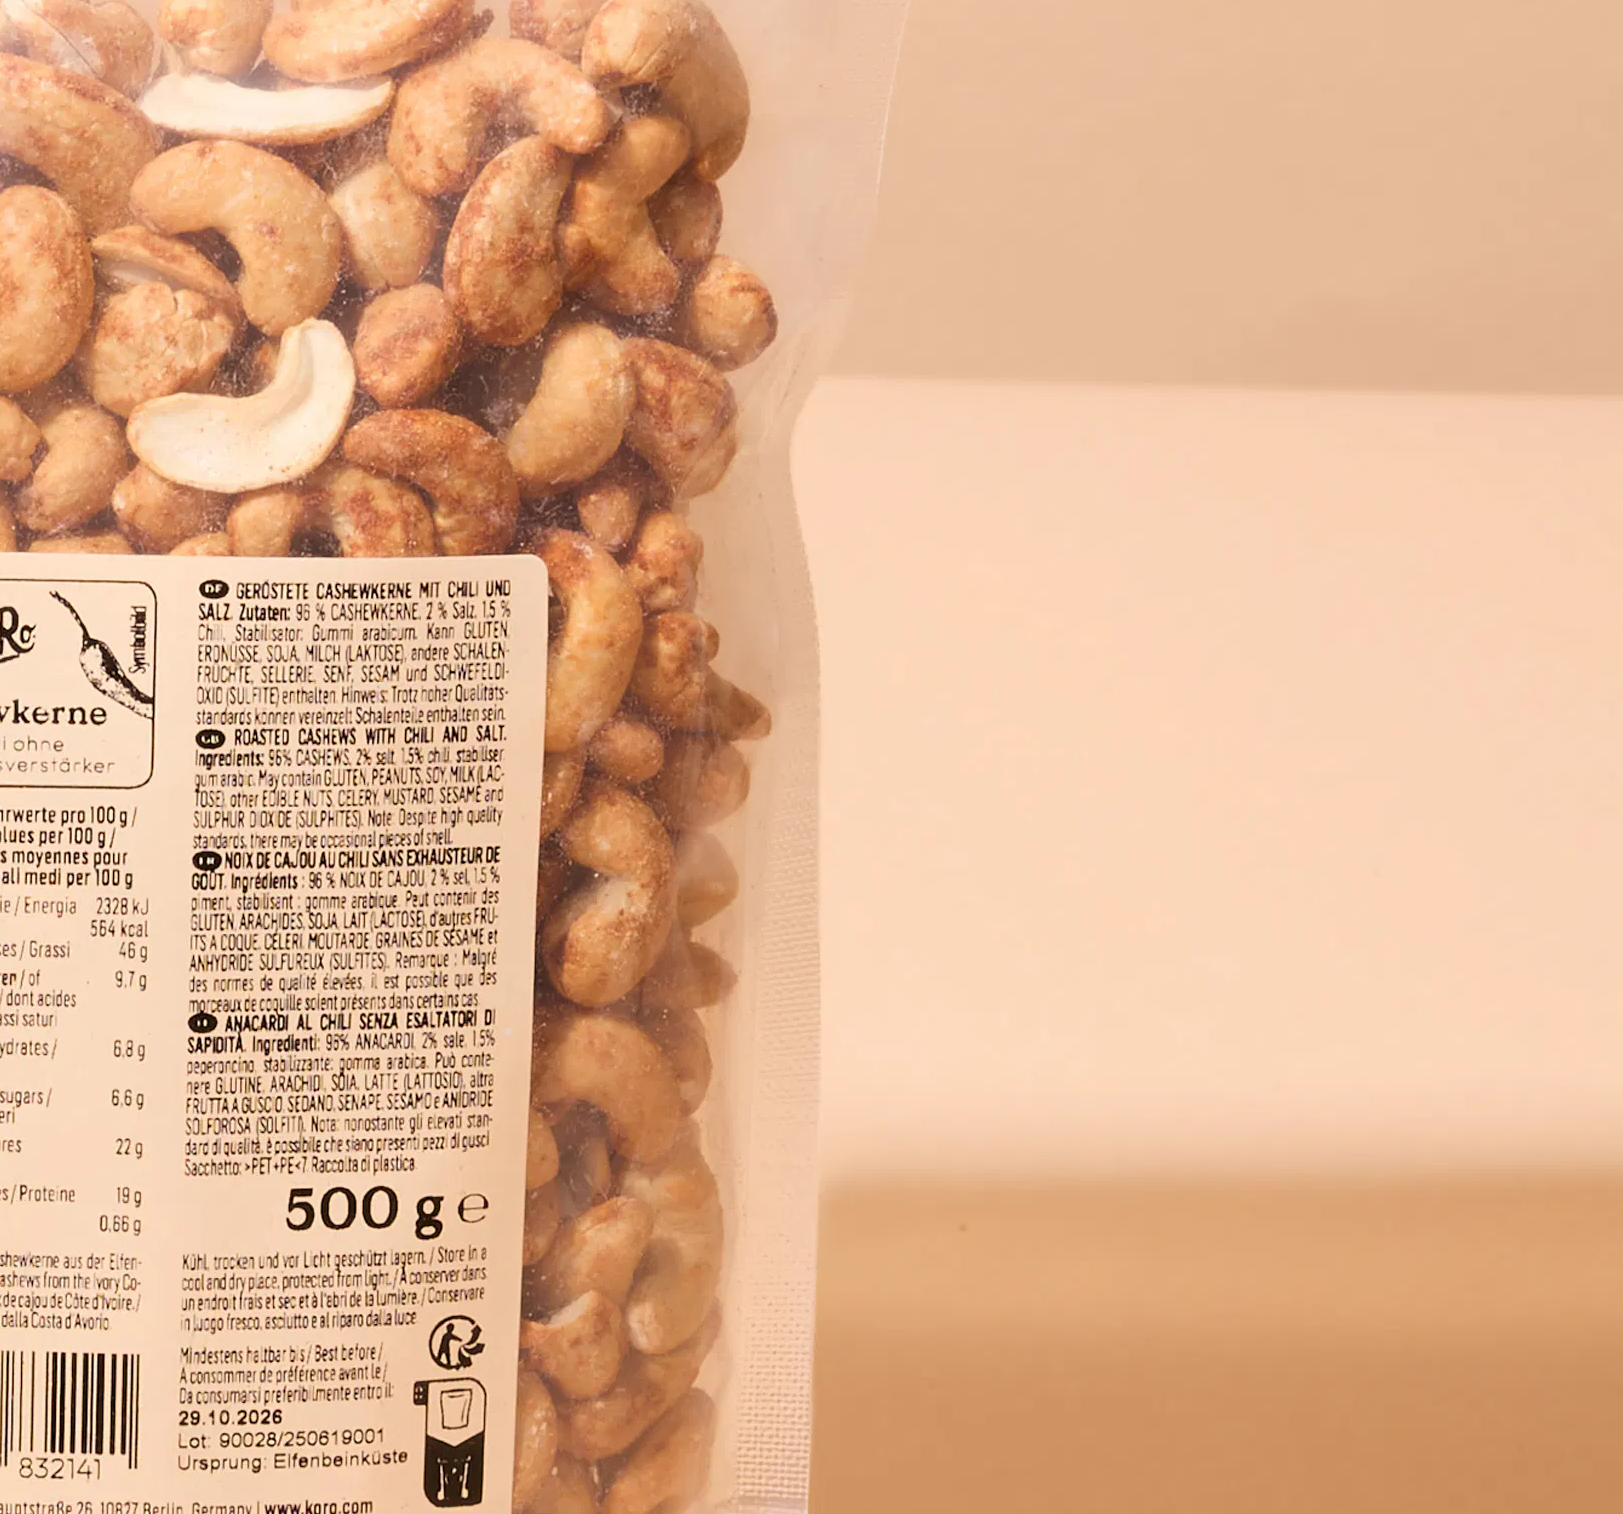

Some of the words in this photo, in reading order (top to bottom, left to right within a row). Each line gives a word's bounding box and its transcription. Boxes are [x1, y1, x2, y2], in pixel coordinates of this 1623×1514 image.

[317, 582, 412, 600] CASHEWKERNE
[419, 582, 440, 598] MIT
[486, 580, 510, 597] UND
[239, 603, 290, 621] Zutaten:
[13, 737, 64, 752] ohne
[235, 728, 289, 746] ROASTED
[298, 727, 356, 745] CASHEWS
[366, 728, 396, 745] WITH
[404, 727, 434, 744] CHILI
[442, 726, 467, 742] AND
[61, 810, 85, 826] pro
[91, 806, 115, 824] 100
[39, 831, 63, 847] per
[68, 827, 93, 844] 100
[11, 851, 88, 869] moyennes
[94, 852, 127, 870] pour
[225, 852, 253, 869] NOIX
[257, 852, 271, 869] DE
[274, 849, 316, 869] CAJOU
[319, 852, 335, 868] AU
[338, 851, 369, 868] CHILI
[372, 848, 403, 867] SANS
[407, 847, 483, 866] EXHAUSTEUR
[486, 846, 500, 863] DE
[25, 869, 61, 885] medi
[67, 873, 91, 888] per
[94, 868, 120, 886] 100
[125, 873, 133, 889] g
[24, 896, 76, 918] Energia
[96, 897, 128, 915] 2328
[132, 898, 148, 915] kJ
[90, 920, 115, 937] 564
[121, 920, 148, 937] kcal
[30, 940, 70, 958] Grassi
[119, 941, 135, 959] 46
[140, 946, 147, 963] g
[29, 969, 40, 986] of
[139, 975, 146, 991] g
[37, 991, 76, 1007] acides
[225, 1013, 289, 1033] ANACARDI
[297, 1014, 312, 1031] AL
[320, 1013, 352, 1031] CHILI
[360, 1012, 398, 1030] SENZA
[406, 1010, 477, 1029] ESALTATORI
[485, 1009, 495, 1026] DI
[138, 1044, 145, 1061] g
[0, 1091, 43, 1107] sugars
[136, 1093, 144, 1110] g
[116, 1138, 131, 1155] 22
[135, 1142, 143, 1159] g
[117, 1187, 130, 1203] 19
[134, 1191, 141, 1208] g
[286, 1186, 398, 1231] 500
[415, 1196, 444, 1240] g
[133, 1220, 141, 1236] g
[63, 1256, 82, 1269] aus
[87, 1253, 105, 1269] der
[44, 1272, 70, 1289] from
[73, 1273, 90, 1289] the
[179, 1409, 282, 1426] 29.10.2026
[220, 1428, 383, 1448] 90028/250619001
[19, 1457, 100, 1480] 832141
[178, 1455, 266, 1474] Ursprung:
[274, 1449, 408, 1469] Elfenbeinküste
